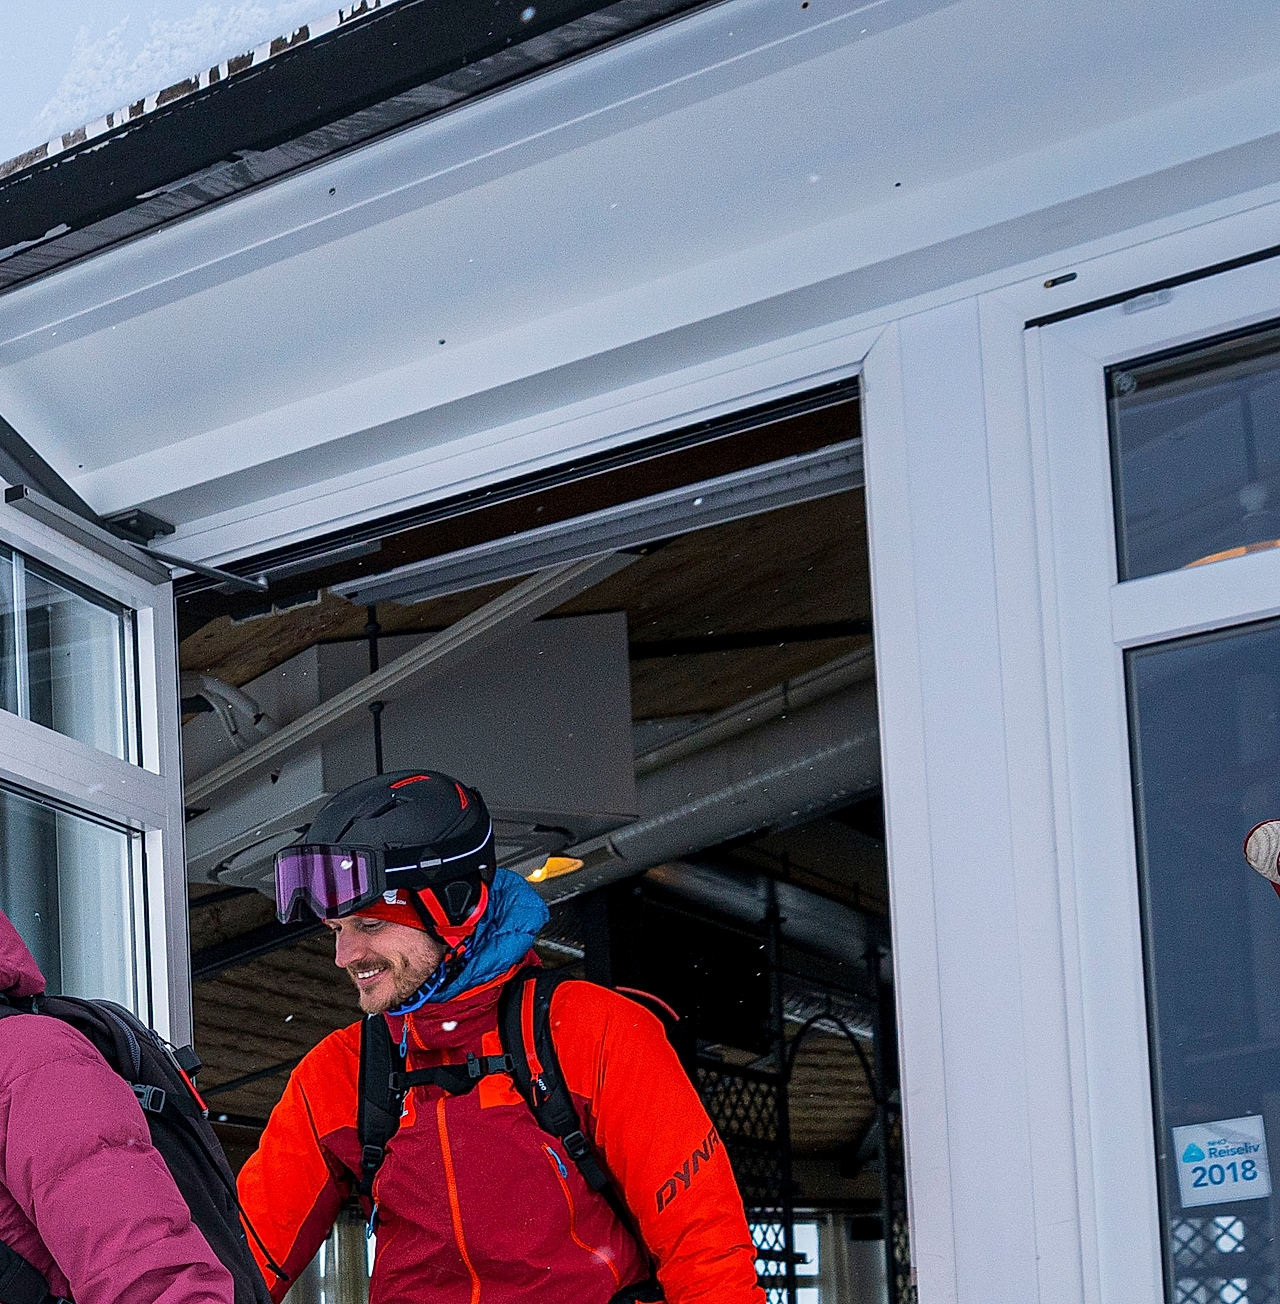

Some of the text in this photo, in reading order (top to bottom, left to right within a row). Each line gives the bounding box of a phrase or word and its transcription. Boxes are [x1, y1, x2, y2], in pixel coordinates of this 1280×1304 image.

[1208, 1142, 1261, 1158] Reiseliv
[655, 1125, 720, 1214] DYNA
[1191, 1159, 1258, 1188] 2018
